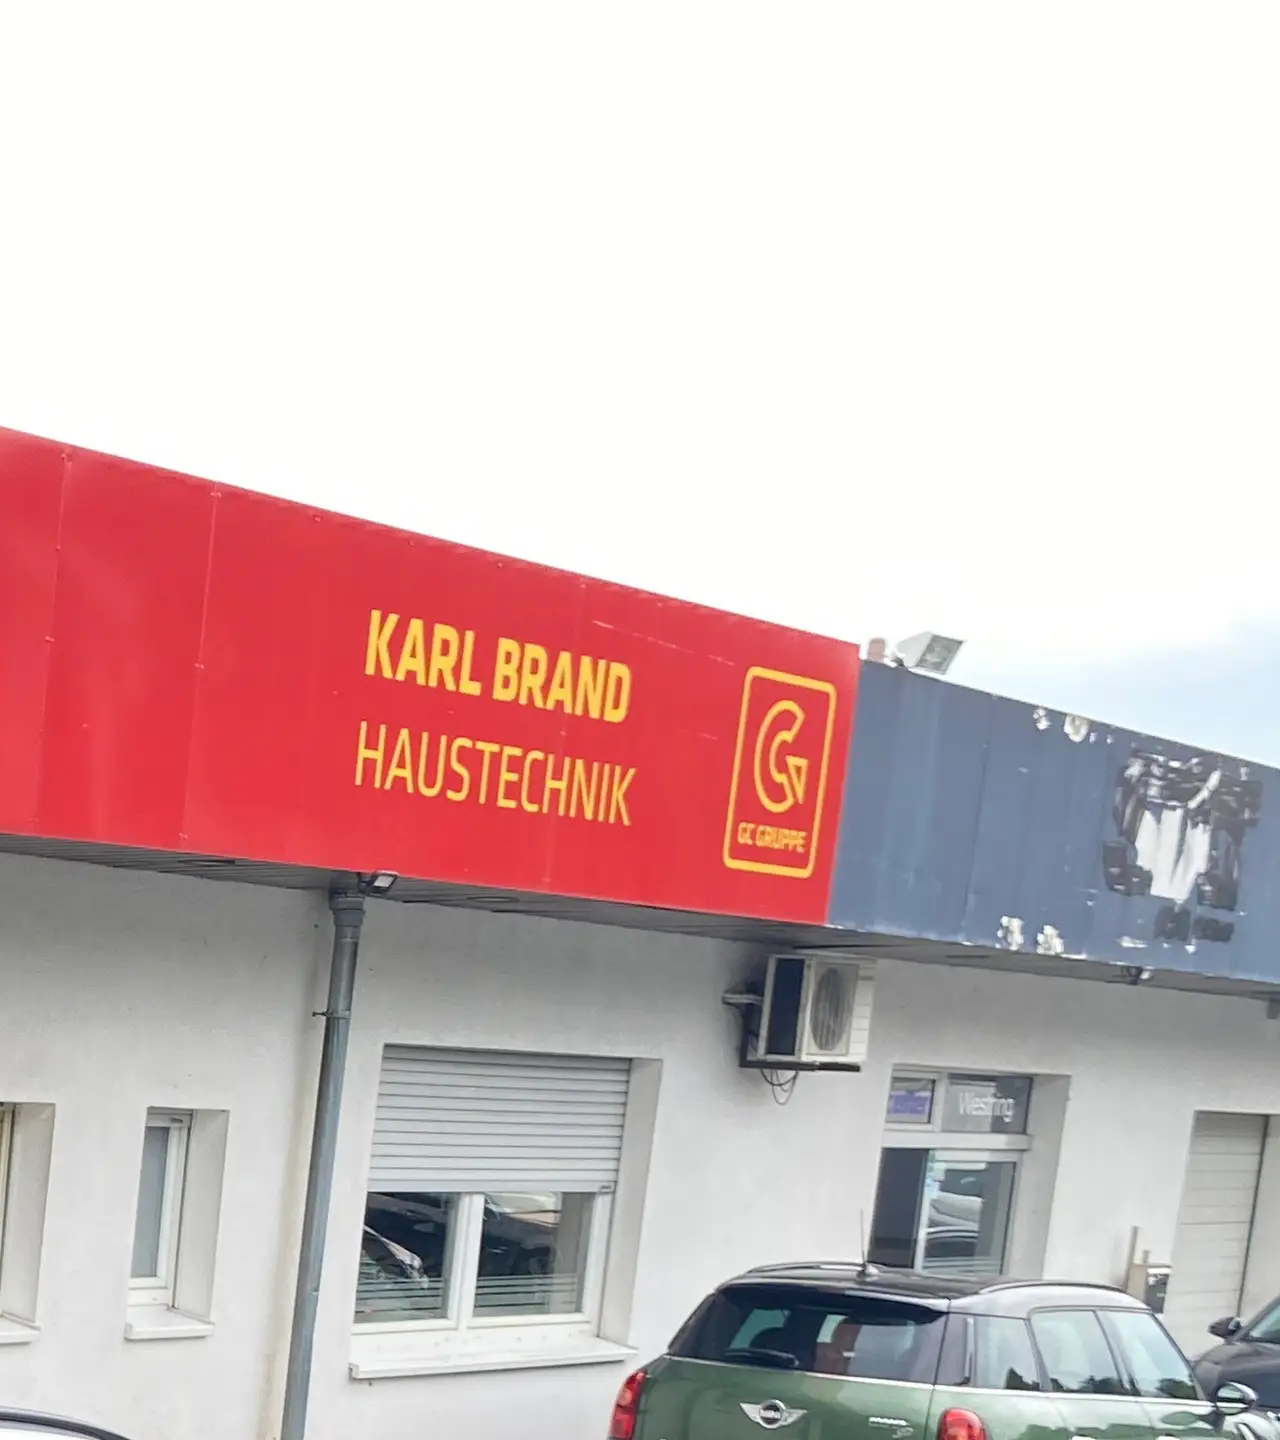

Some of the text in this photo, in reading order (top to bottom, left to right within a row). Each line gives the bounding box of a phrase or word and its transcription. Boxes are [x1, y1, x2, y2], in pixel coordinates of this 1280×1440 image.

[364, 608, 632, 724] KARL BRAND
[354, 719, 637, 827] HAUSTECHNIK
[755, 824, 808, 853] GRUPPE
